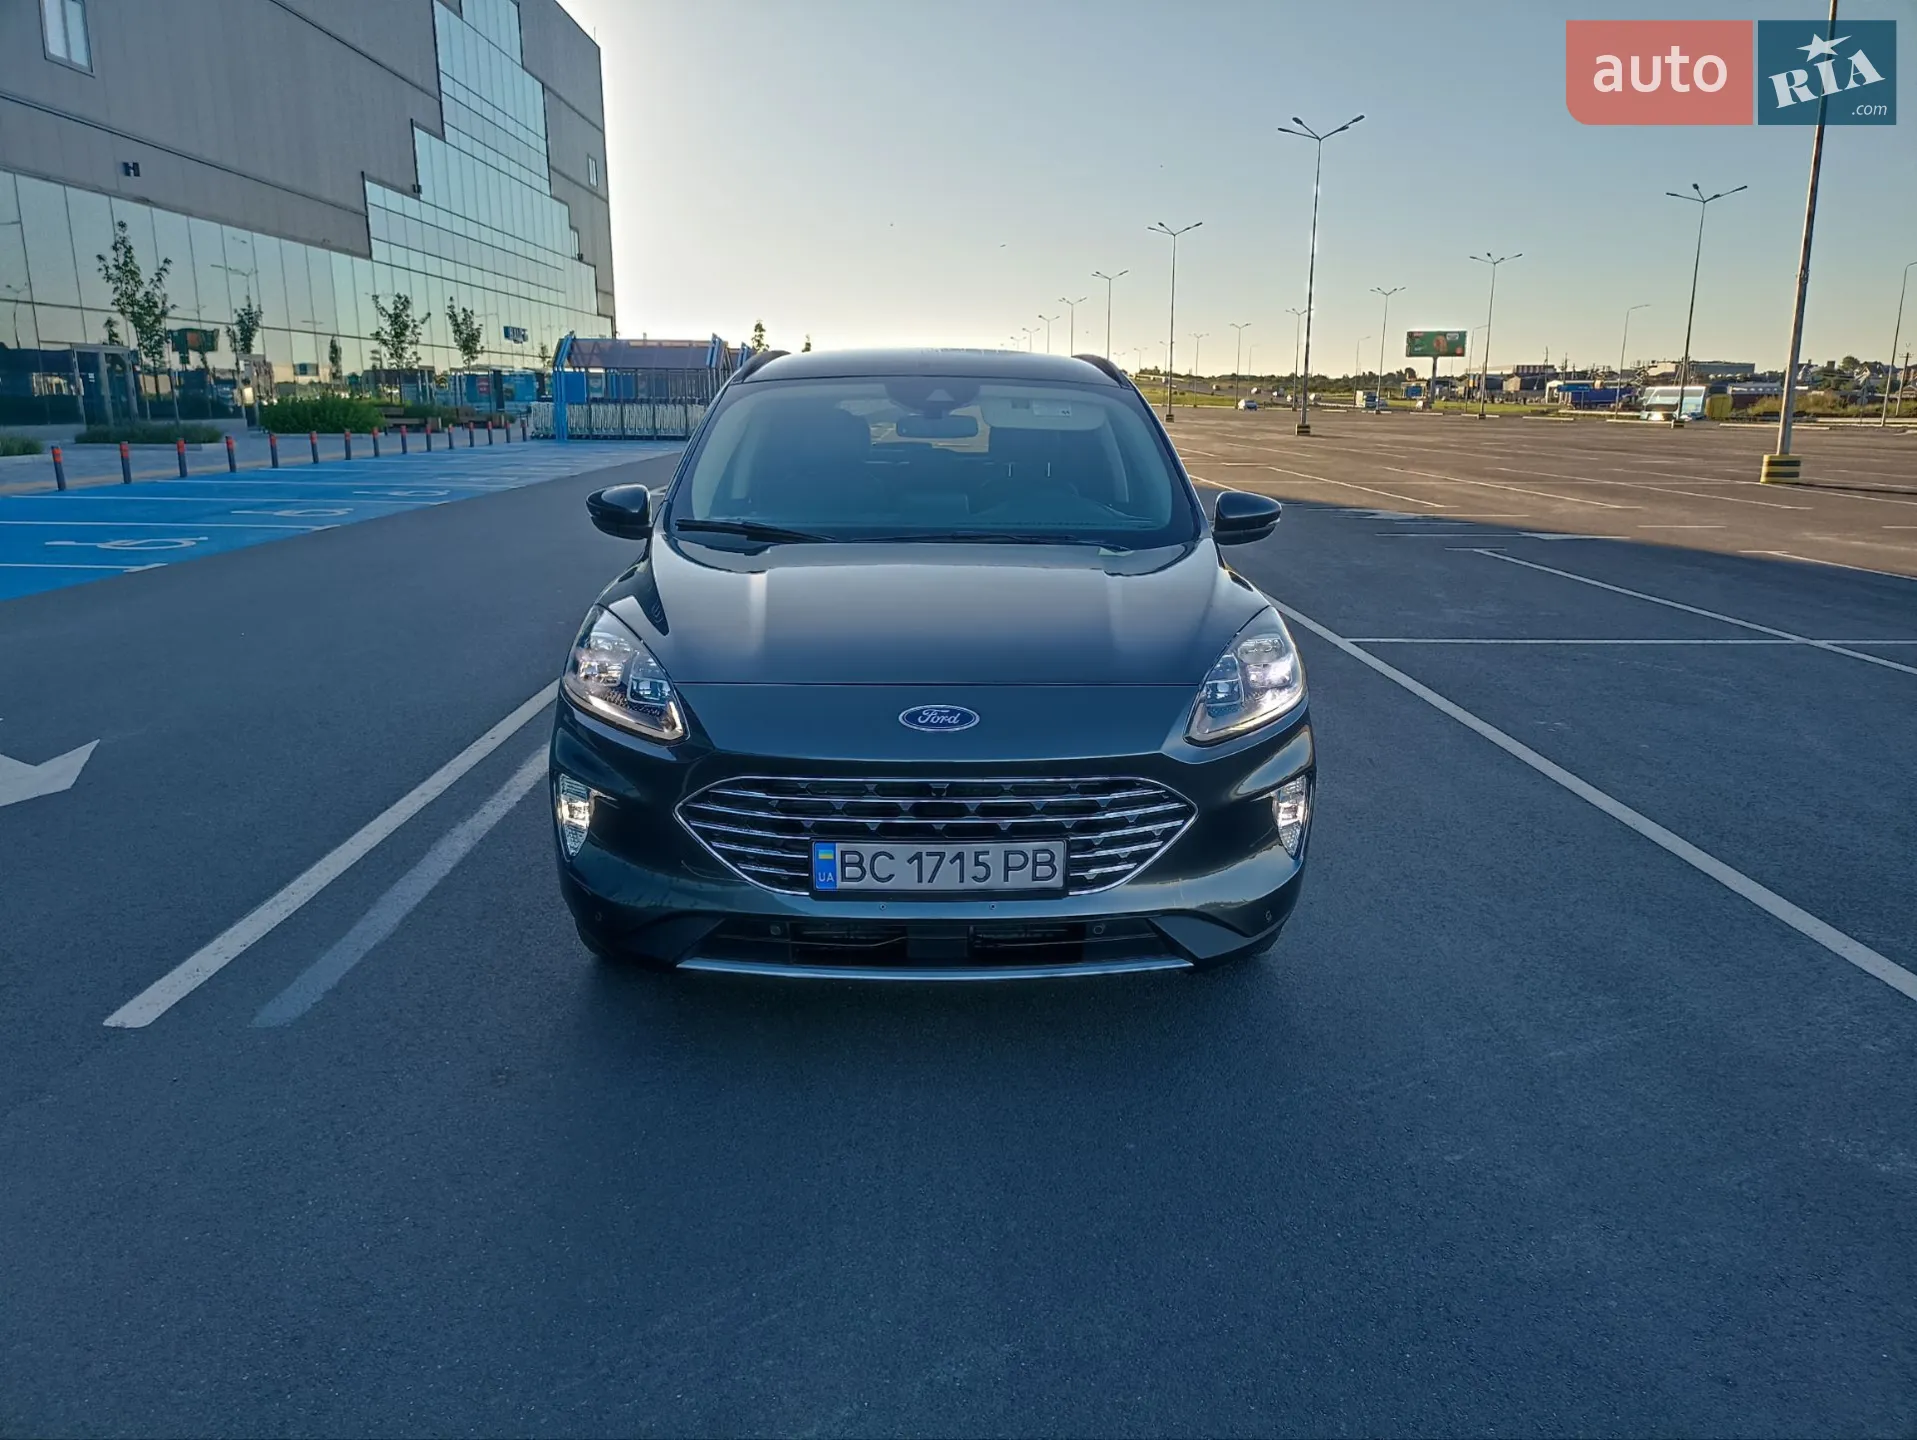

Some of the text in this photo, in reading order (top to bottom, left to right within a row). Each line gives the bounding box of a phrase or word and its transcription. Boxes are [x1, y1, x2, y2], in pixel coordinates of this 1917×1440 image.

[917, 709, 961, 724] Ford
[840, 849, 1058, 884] BC 1715 PB
[819, 872, 834, 883] UA
